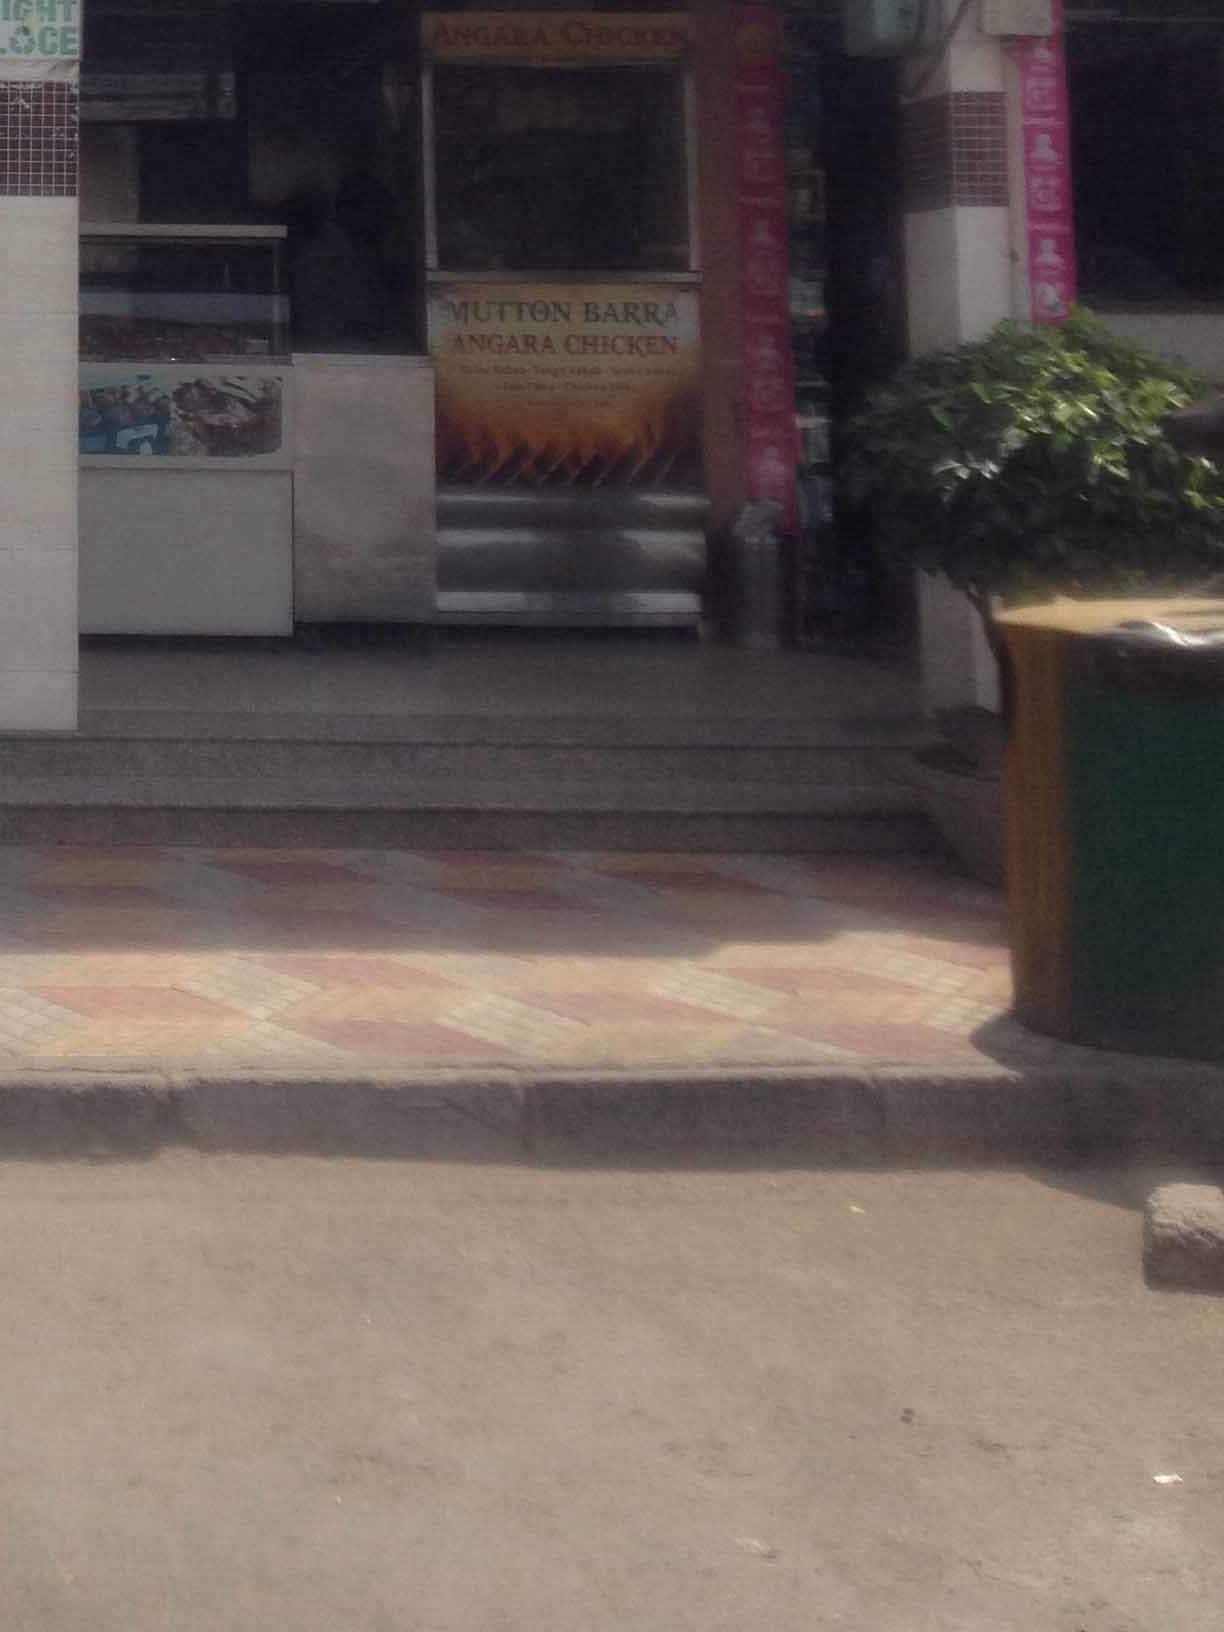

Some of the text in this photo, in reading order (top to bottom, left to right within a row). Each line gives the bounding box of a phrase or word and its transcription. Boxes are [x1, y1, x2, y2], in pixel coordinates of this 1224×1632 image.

[446, 300, 678, 326] MUTTON BARRA
[451, 333, 681, 358] ANGARA CHICKEN
